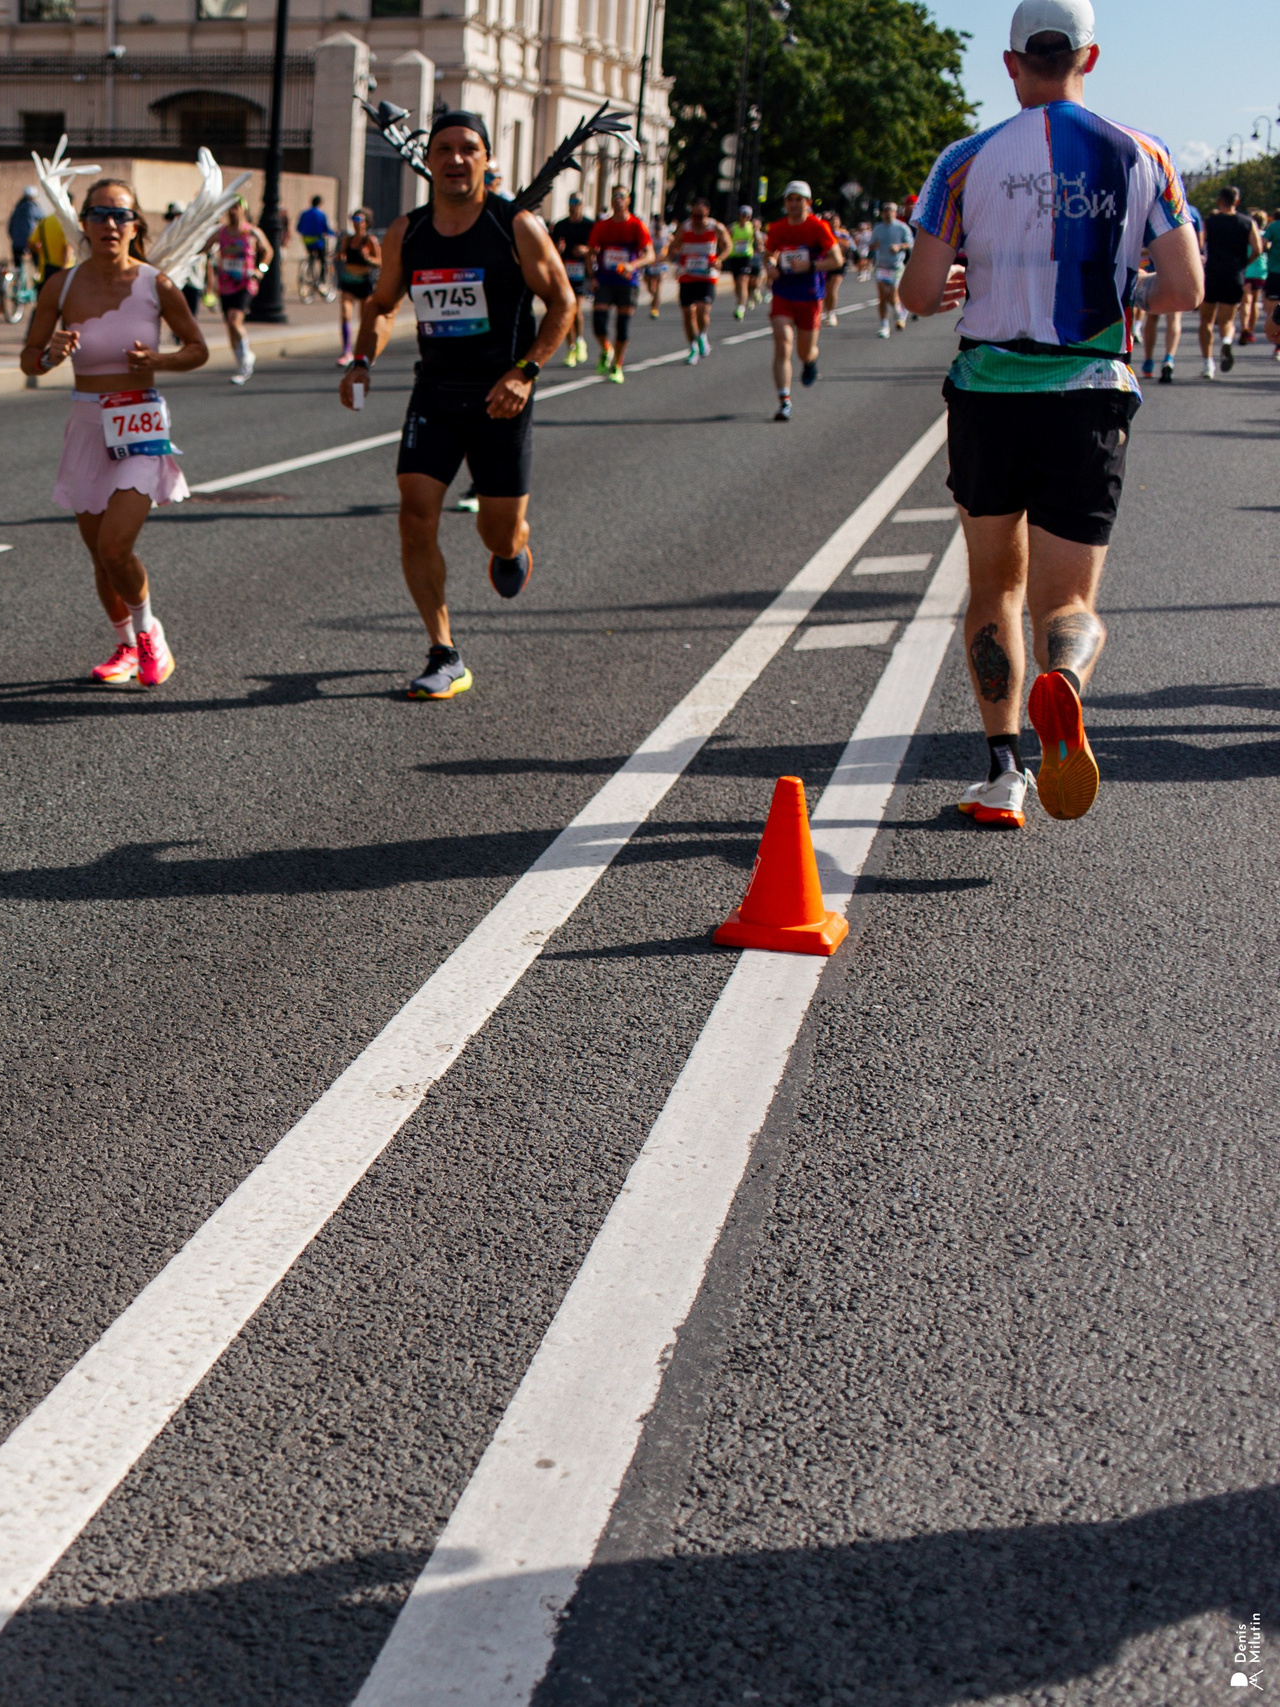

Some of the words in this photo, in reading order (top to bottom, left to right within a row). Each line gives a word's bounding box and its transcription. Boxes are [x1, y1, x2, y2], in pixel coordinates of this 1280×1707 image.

[1025, 220, 1084, 231] ЗАЕГ
[423, 287, 476, 308] 1745
[112, 411, 164, 437] 7482
